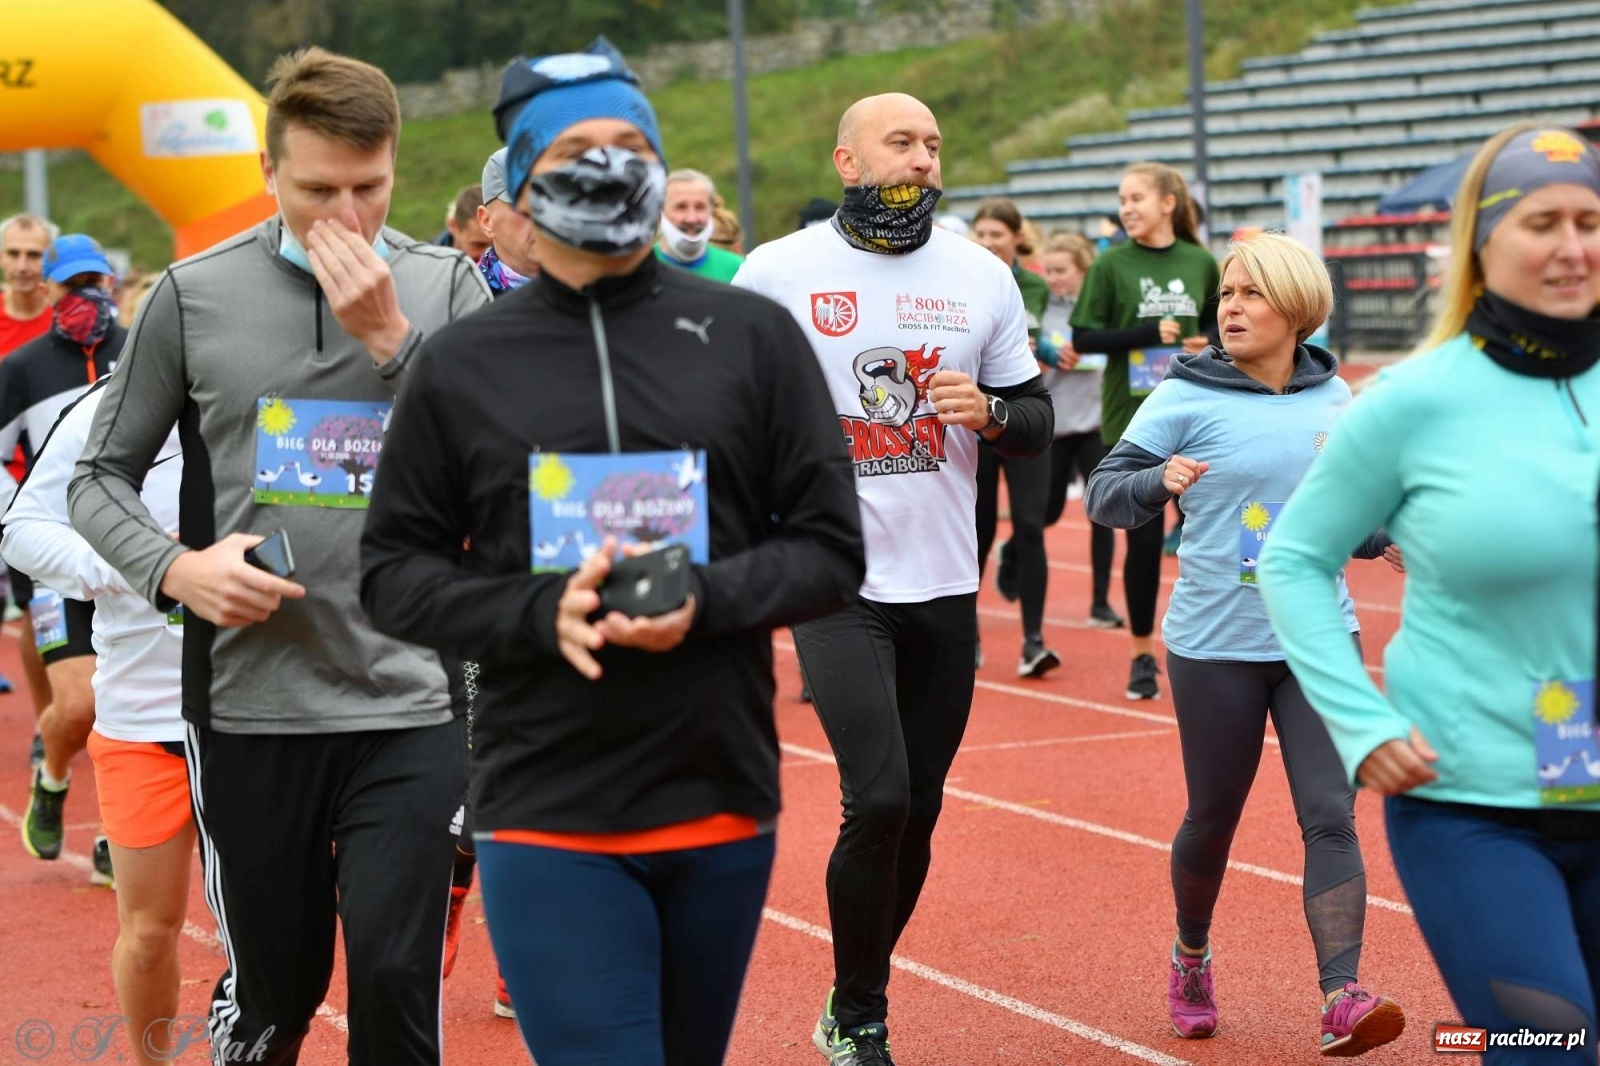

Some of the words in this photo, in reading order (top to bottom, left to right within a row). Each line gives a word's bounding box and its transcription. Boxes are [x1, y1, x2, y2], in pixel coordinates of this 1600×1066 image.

[915, 297, 945, 312] 800
[898, 323, 922, 331] CROSS
[276, 436, 305, 450] BIEG
[312, 438, 336, 452] DLA
